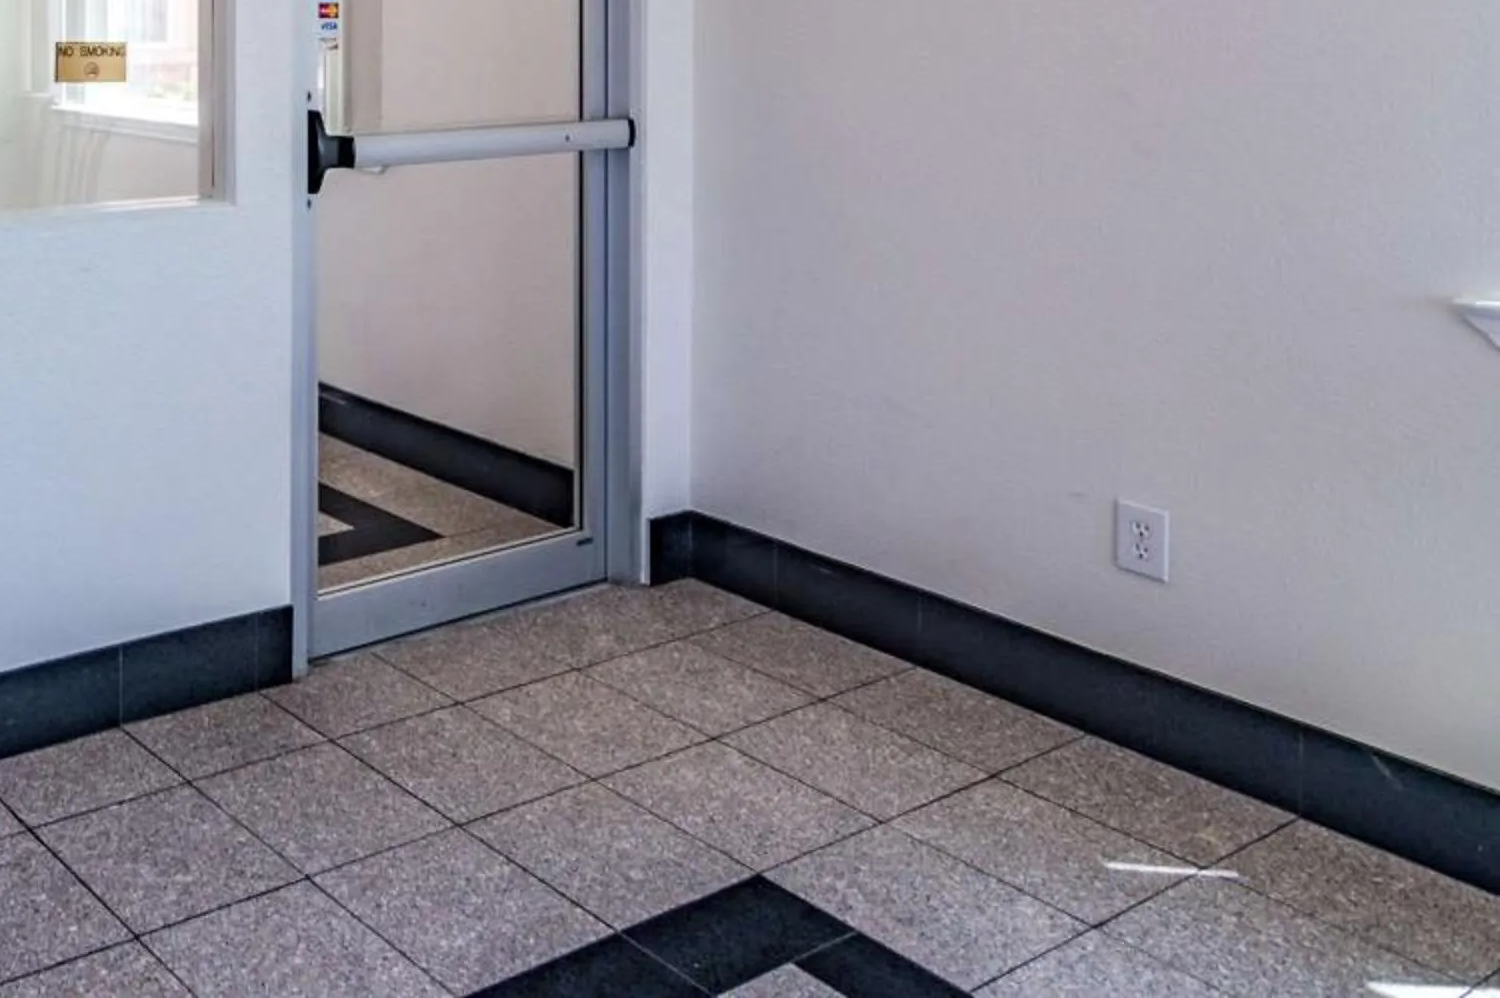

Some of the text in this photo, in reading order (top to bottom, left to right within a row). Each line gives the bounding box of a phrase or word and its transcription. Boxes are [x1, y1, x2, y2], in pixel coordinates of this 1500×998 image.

[321, 21, 338, 31] VISA
[56, 45, 127, 57] NO SMOKING
